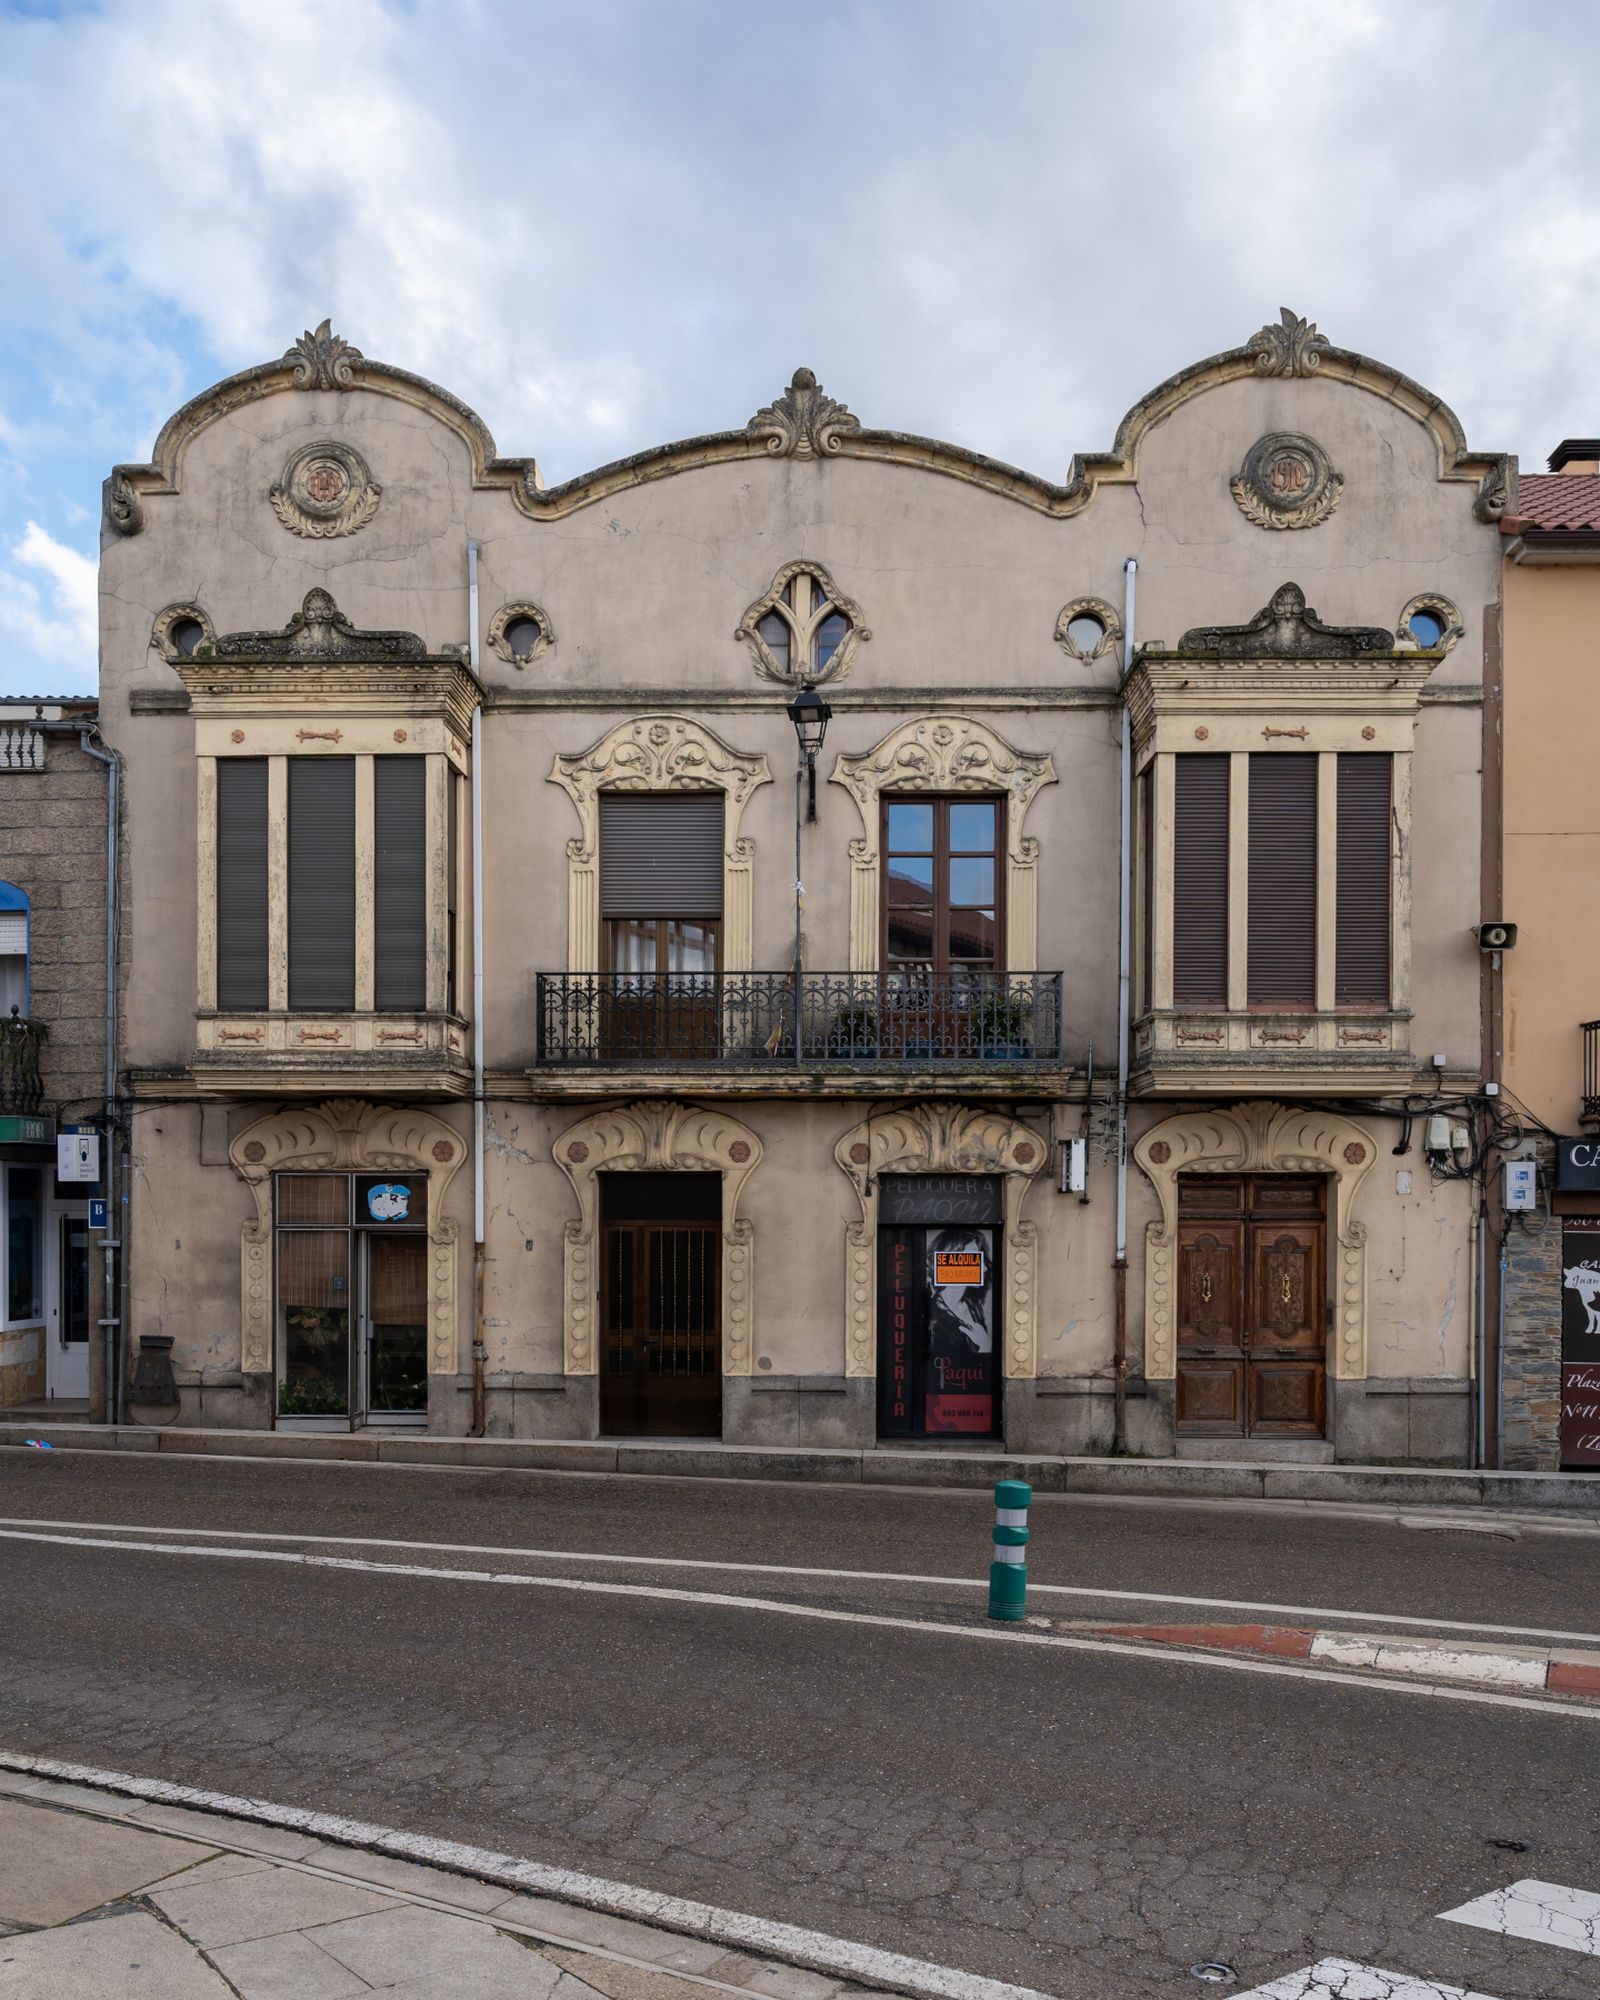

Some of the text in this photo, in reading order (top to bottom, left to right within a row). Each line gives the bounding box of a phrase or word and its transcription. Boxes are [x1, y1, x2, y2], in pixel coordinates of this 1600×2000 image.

[25, 1120, 44, 1139] BAR
[95, 1203, 104, 1215] B
[937, 1254, 980, 1265] SE ALQUILA
[1580, 1260, 1600, 1269] CA
